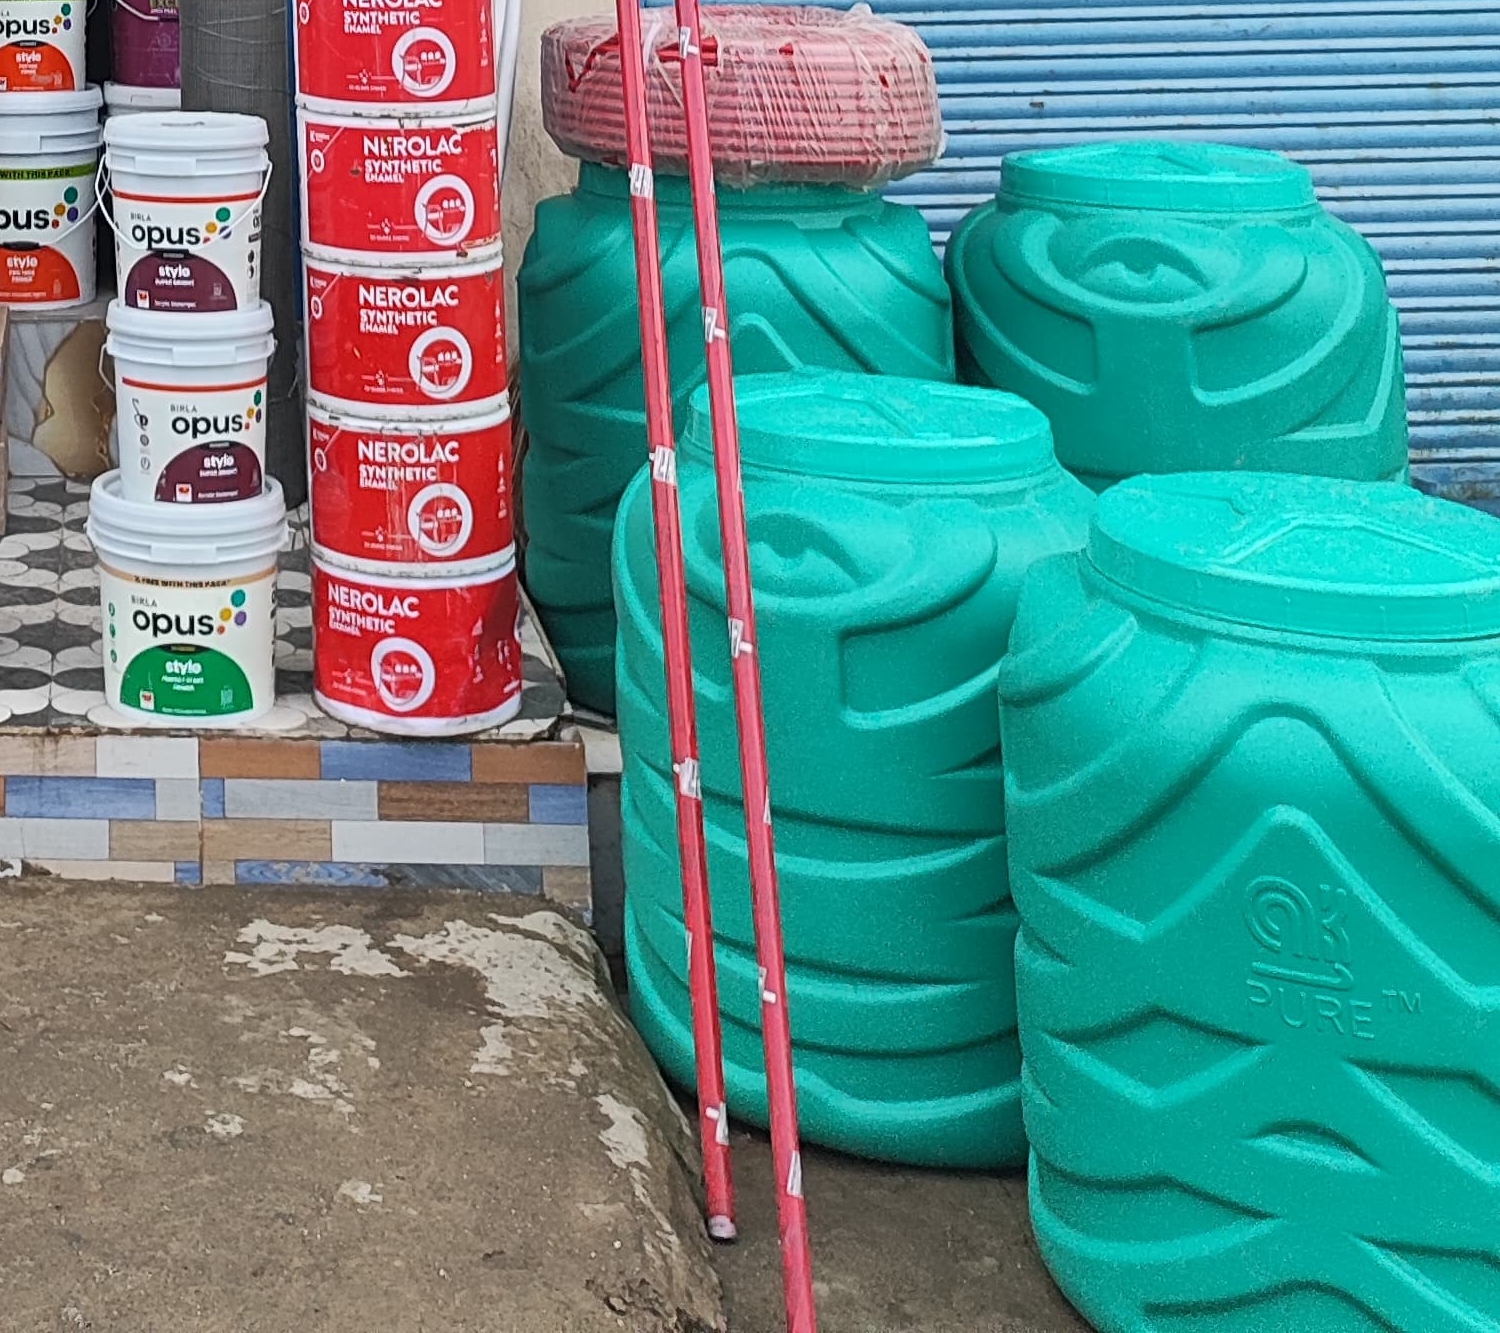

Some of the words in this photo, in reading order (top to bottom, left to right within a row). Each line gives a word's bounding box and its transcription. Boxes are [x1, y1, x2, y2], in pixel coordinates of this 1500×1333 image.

[344, 11, 420, 25] SYNTHETIC
[344, 23, 382, 35] ENAMEL
[363, 134, 462, 157] NEROLAC
[364, 159, 442, 174] SYNTHETIC
[365, 173, 404, 183] ENAMEL
[130, 212, 151, 221] BIRLA
[132, 223, 200, 250] opus
[358, 284, 459, 307] NEROLAC
[360, 309, 438, 326] SYNTHETIC
[360, 322, 399, 335] ENAMEL
[170, 403, 198, 413] BIRLA
[171, 413, 243, 439] opus
[358, 439, 460, 463] NEROLAC
[359, 463, 437, 481] SYNTHETIC
[360, 477, 398, 491] ENAMEL
[328, 581, 420, 619] NEROLAC
[132, 609, 214, 638] opus
[329, 605, 396, 634] SYNTHETIC
[1246, 978, 1375, 1041] PURE
